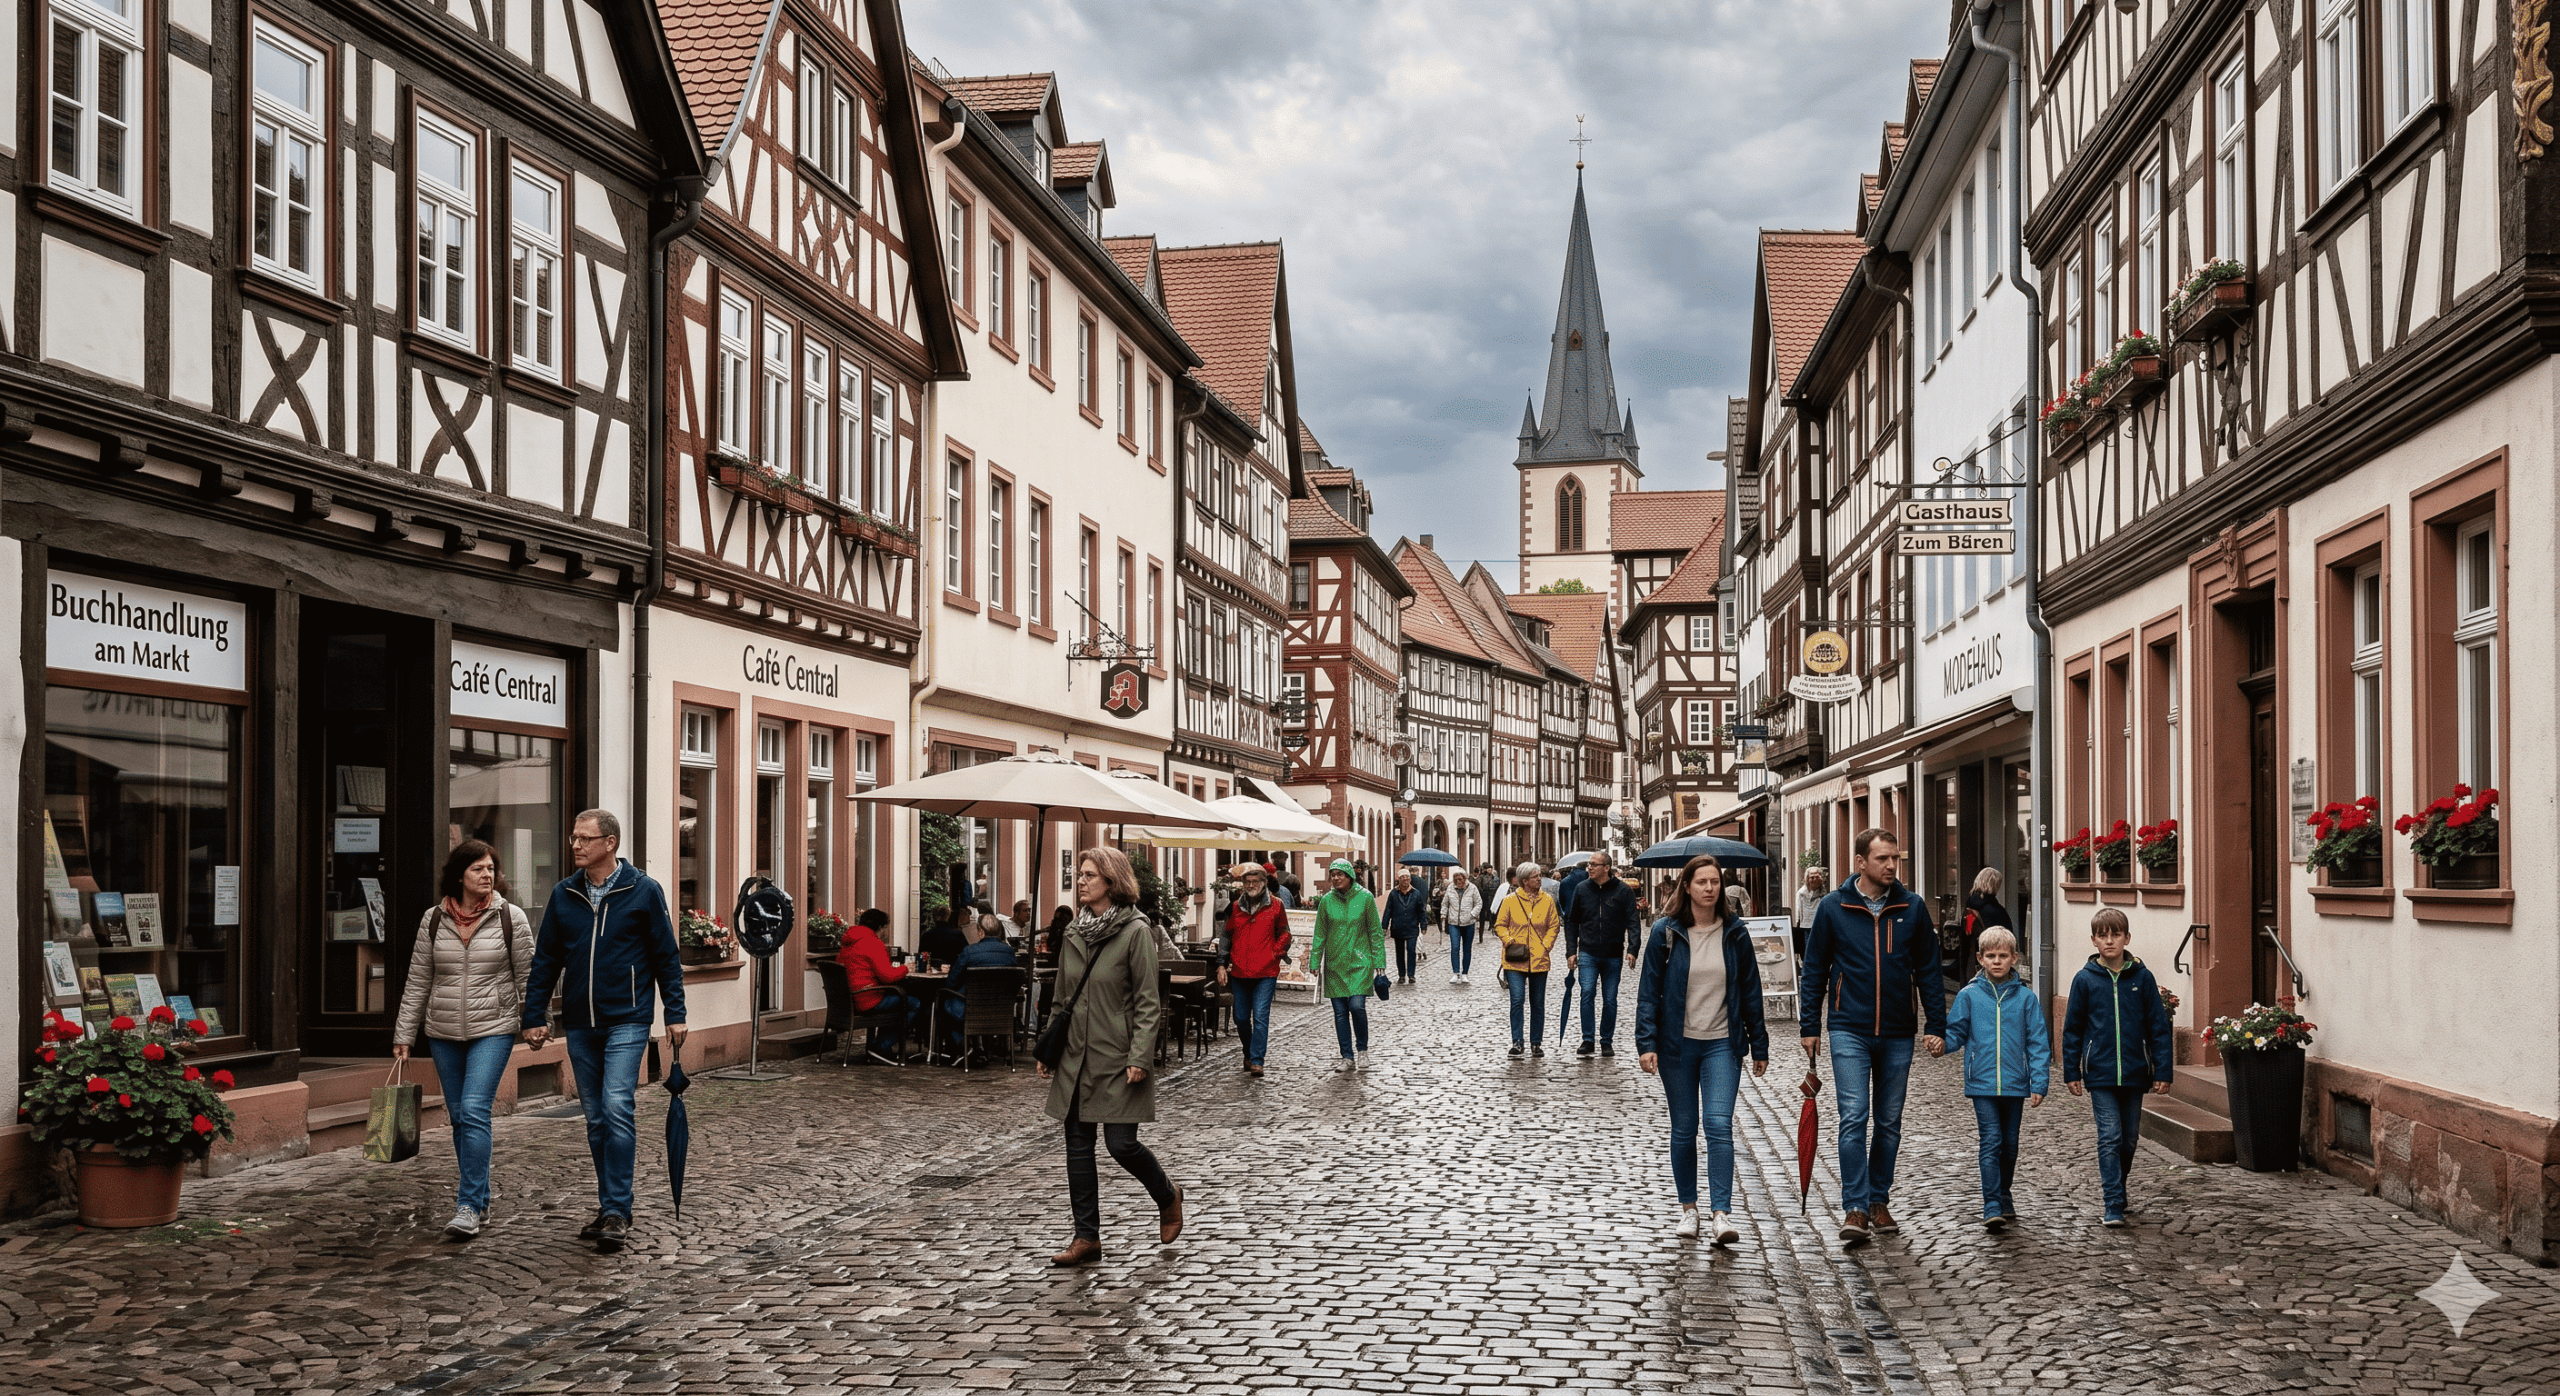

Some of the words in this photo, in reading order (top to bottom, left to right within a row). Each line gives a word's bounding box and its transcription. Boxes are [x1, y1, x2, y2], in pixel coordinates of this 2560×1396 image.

[1905, 503, 2003, 520] Gasthaus
[1902, 536, 1941, 550] Zum
[51, 582, 229, 652] Buchhandlung
[94, 642, 125, 664] am
[132, 641, 190, 673] Markt
[743, 644, 780, 687] Café
[785, 654, 838, 698] Central
[450, 660, 490, 695] Café
[495, 667, 556, 705] Central
